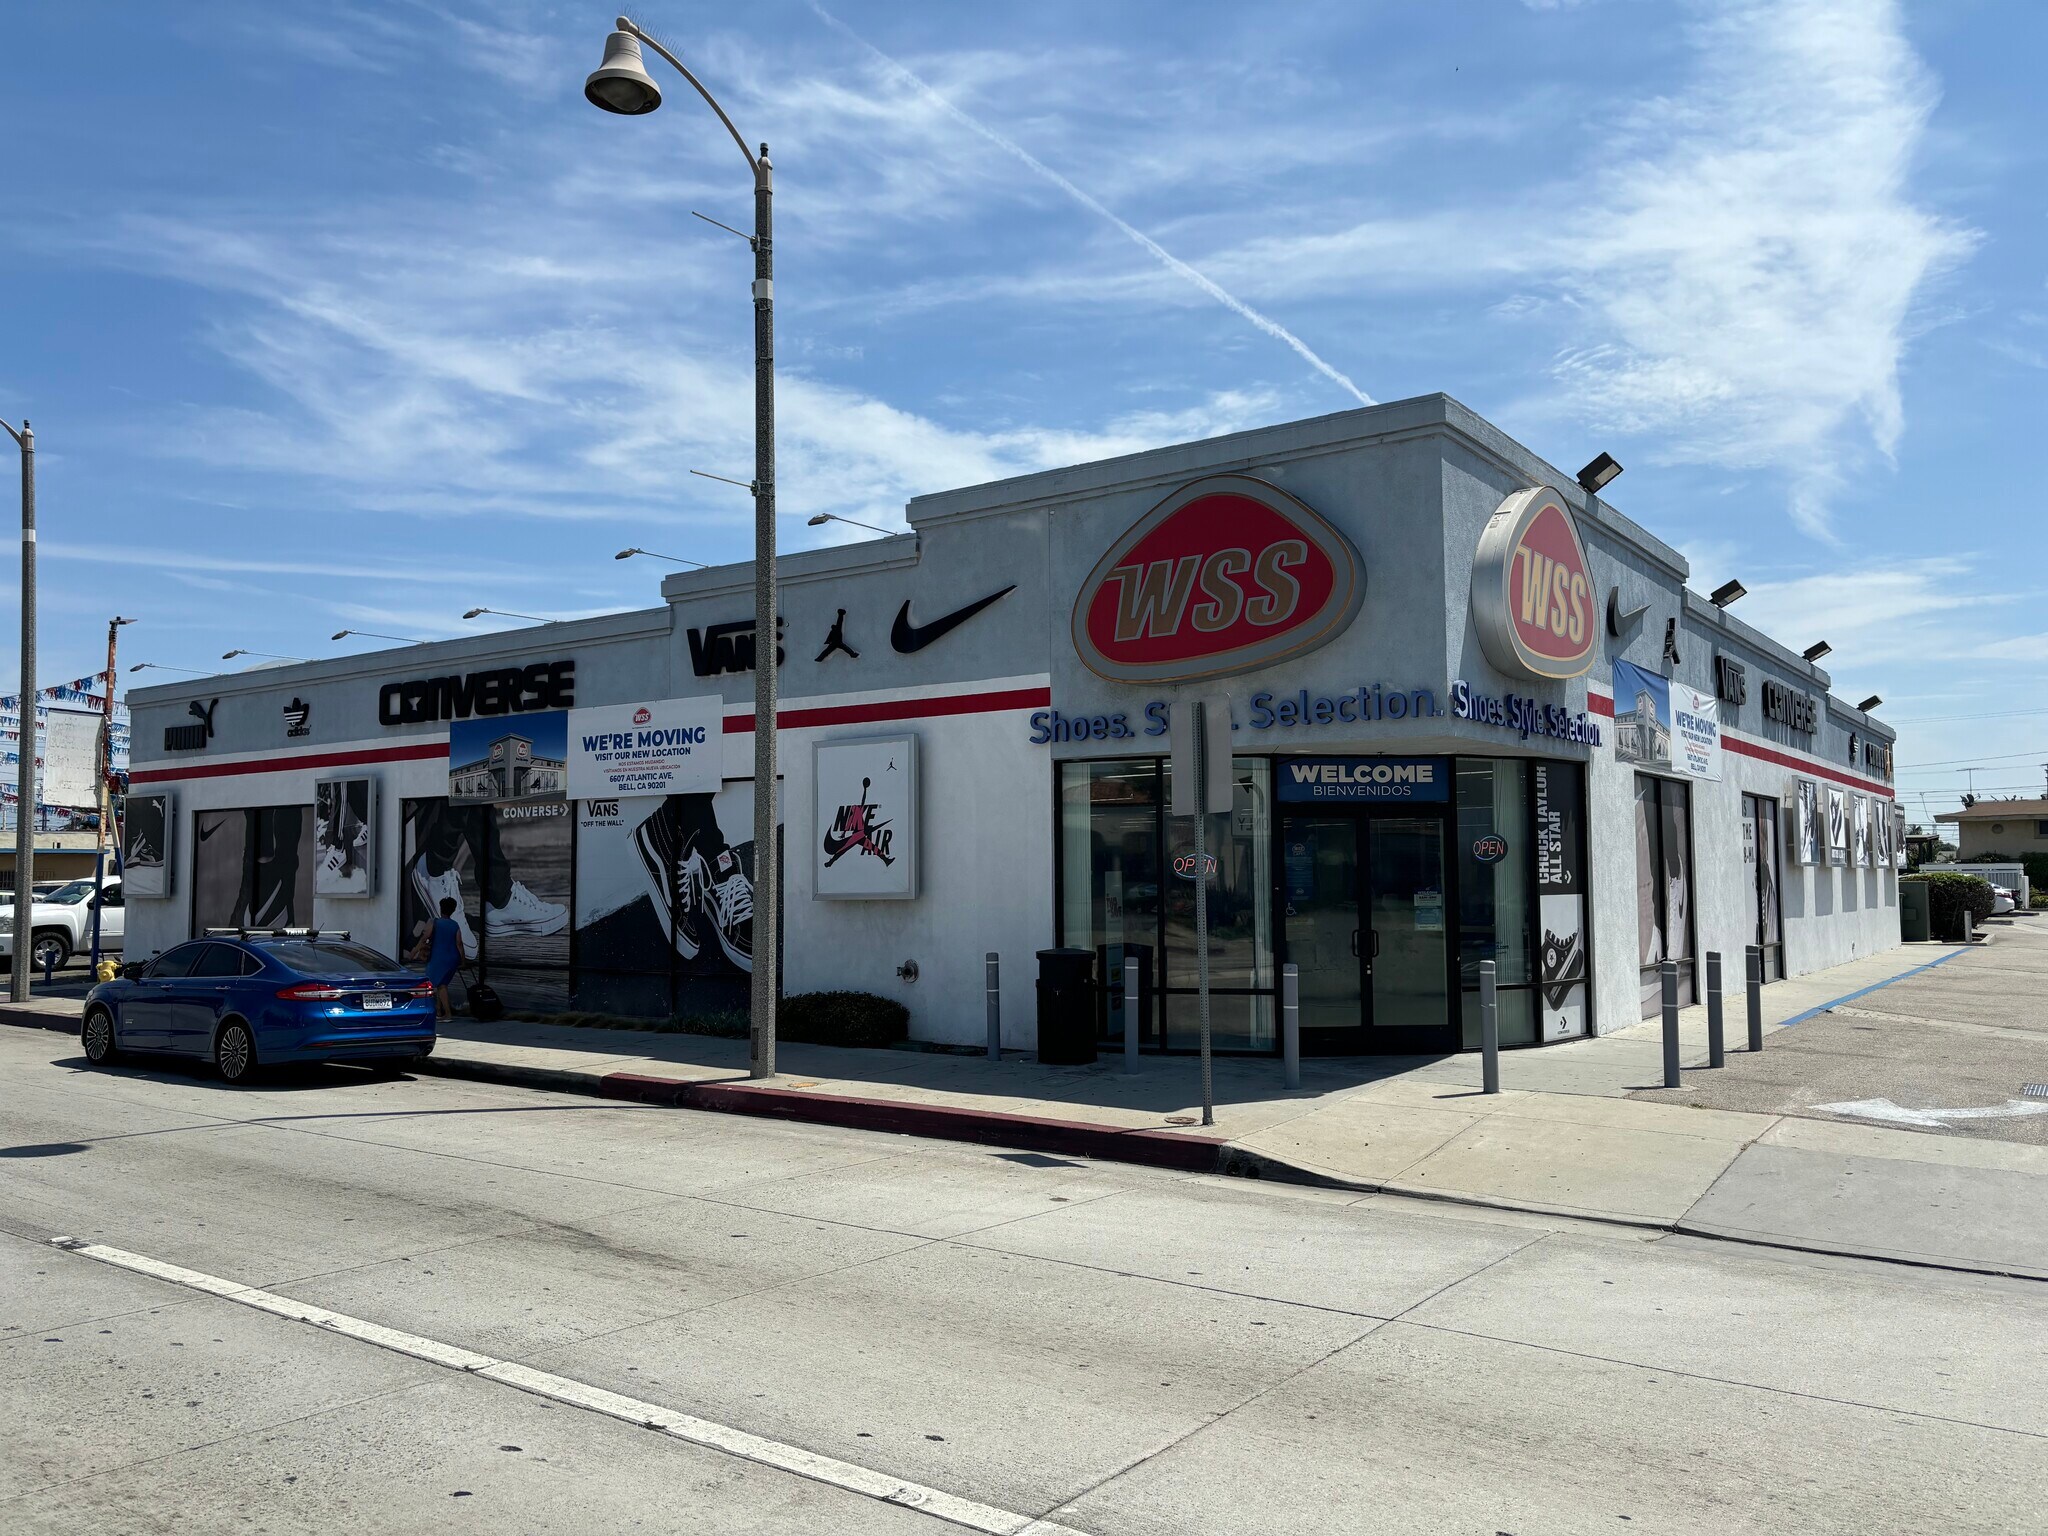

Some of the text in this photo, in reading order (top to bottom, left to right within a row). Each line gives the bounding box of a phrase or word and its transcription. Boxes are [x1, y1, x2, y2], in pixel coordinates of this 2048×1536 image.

[1101, 539, 1308, 642] WSS
[1516, 544, 1587, 645] WSS
[379, 660, 575, 726] CONVERSE
[1715, 655, 1747, 706] VANS
[634, 712, 649, 722] WSS
[1029, 711, 1135, 745] Shoes.
[1249, 682, 1444, 730] Selection.
[1762, 679, 1817, 735] CONVERSE
[1675, 709, 1717, 738] WE'RE MOVING
[582, 726, 706, 752] WE'RE MOVING
[594, 747, 691, 761] VISIT OUR NEW LOCATION
[609, 772, 674, 783] 6607 ATLANTIC AVE,
[618, 781, 666, 792] BELL, CA 90201
[1290, 765, 1433, 784] WELCOME
[1313, 785, 1412, 796] BIENVENIDOS
[503, 805, 559, 818] CONVERSE
[587, 799, 619, 818] VANS
[833, 804, 879, 832] NIKE
[860, 829, 893, 856] AIR
[1473, 840, 1504, 855] OPEN
[1548, 811, 1562, 884] ALL STAR
[1173, 857, 1217, 874] OPN
[1538, 828, 1550, 884] CHUCK
